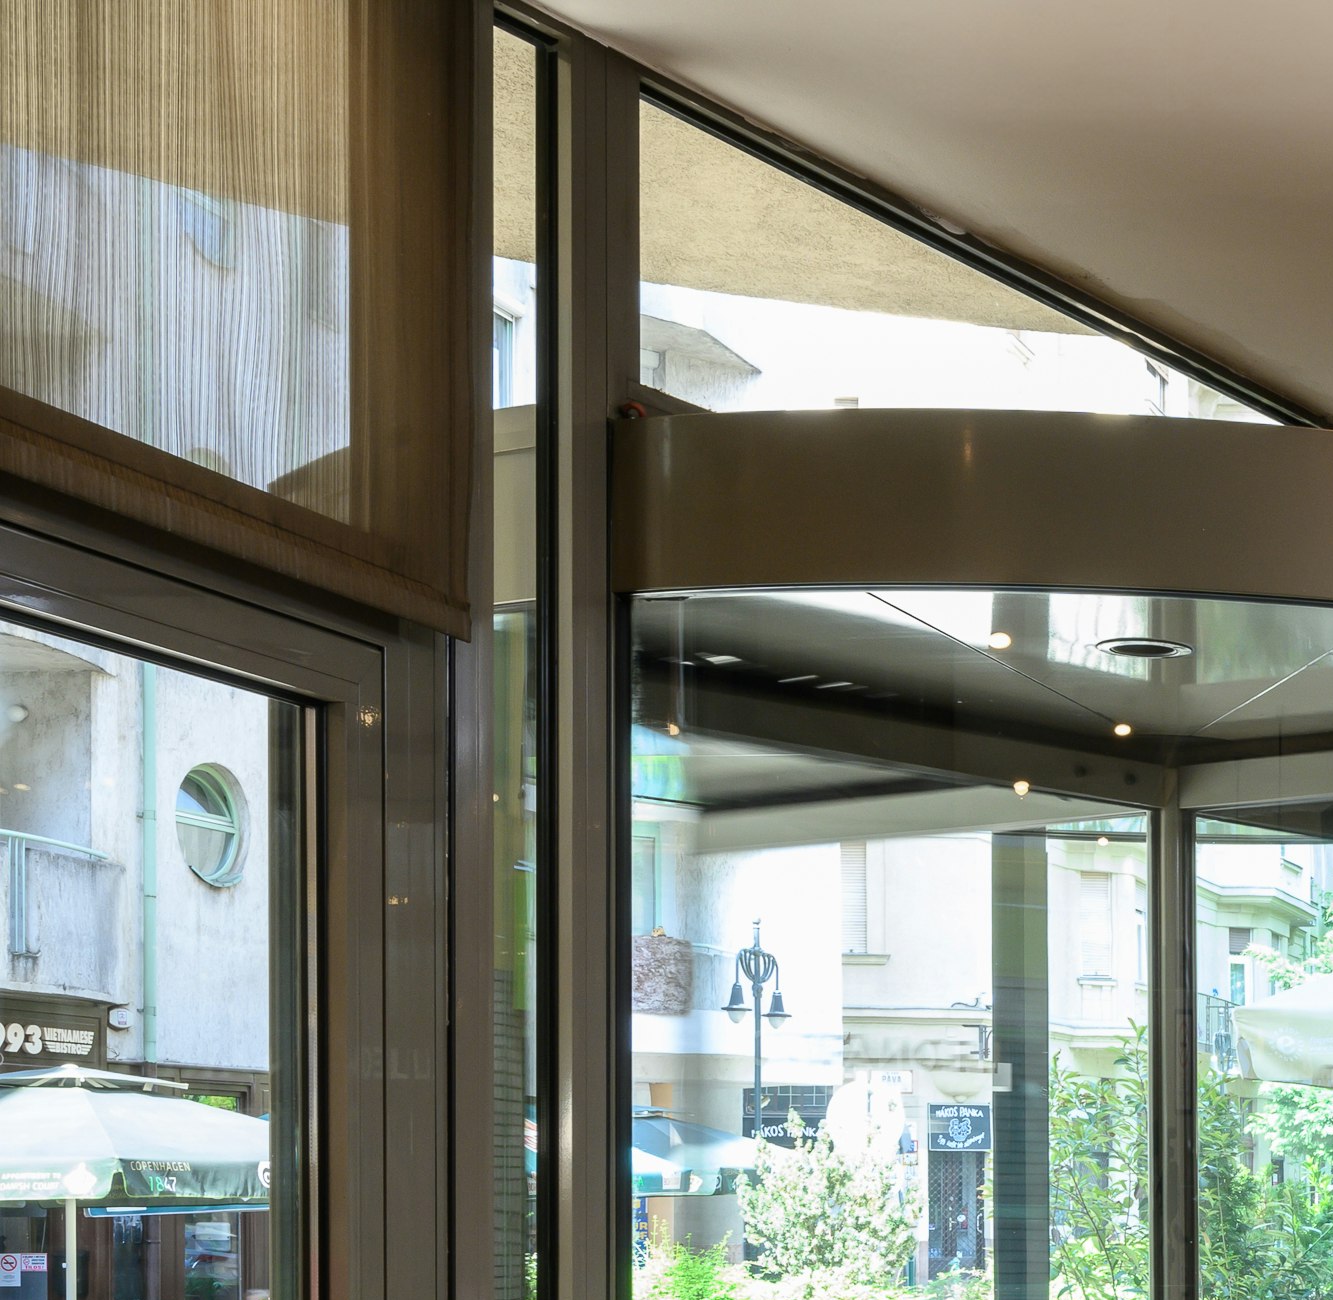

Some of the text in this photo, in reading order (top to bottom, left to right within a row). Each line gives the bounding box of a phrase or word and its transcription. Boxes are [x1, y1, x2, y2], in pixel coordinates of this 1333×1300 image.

[43, 1027, 94, 1045] VIETNAMESE
[54, 1043, 83, 1056] BISTRO
[130, 1161, 191, 1172] COPENHAGEN
[148, 1176, 177, 1192] 1847
